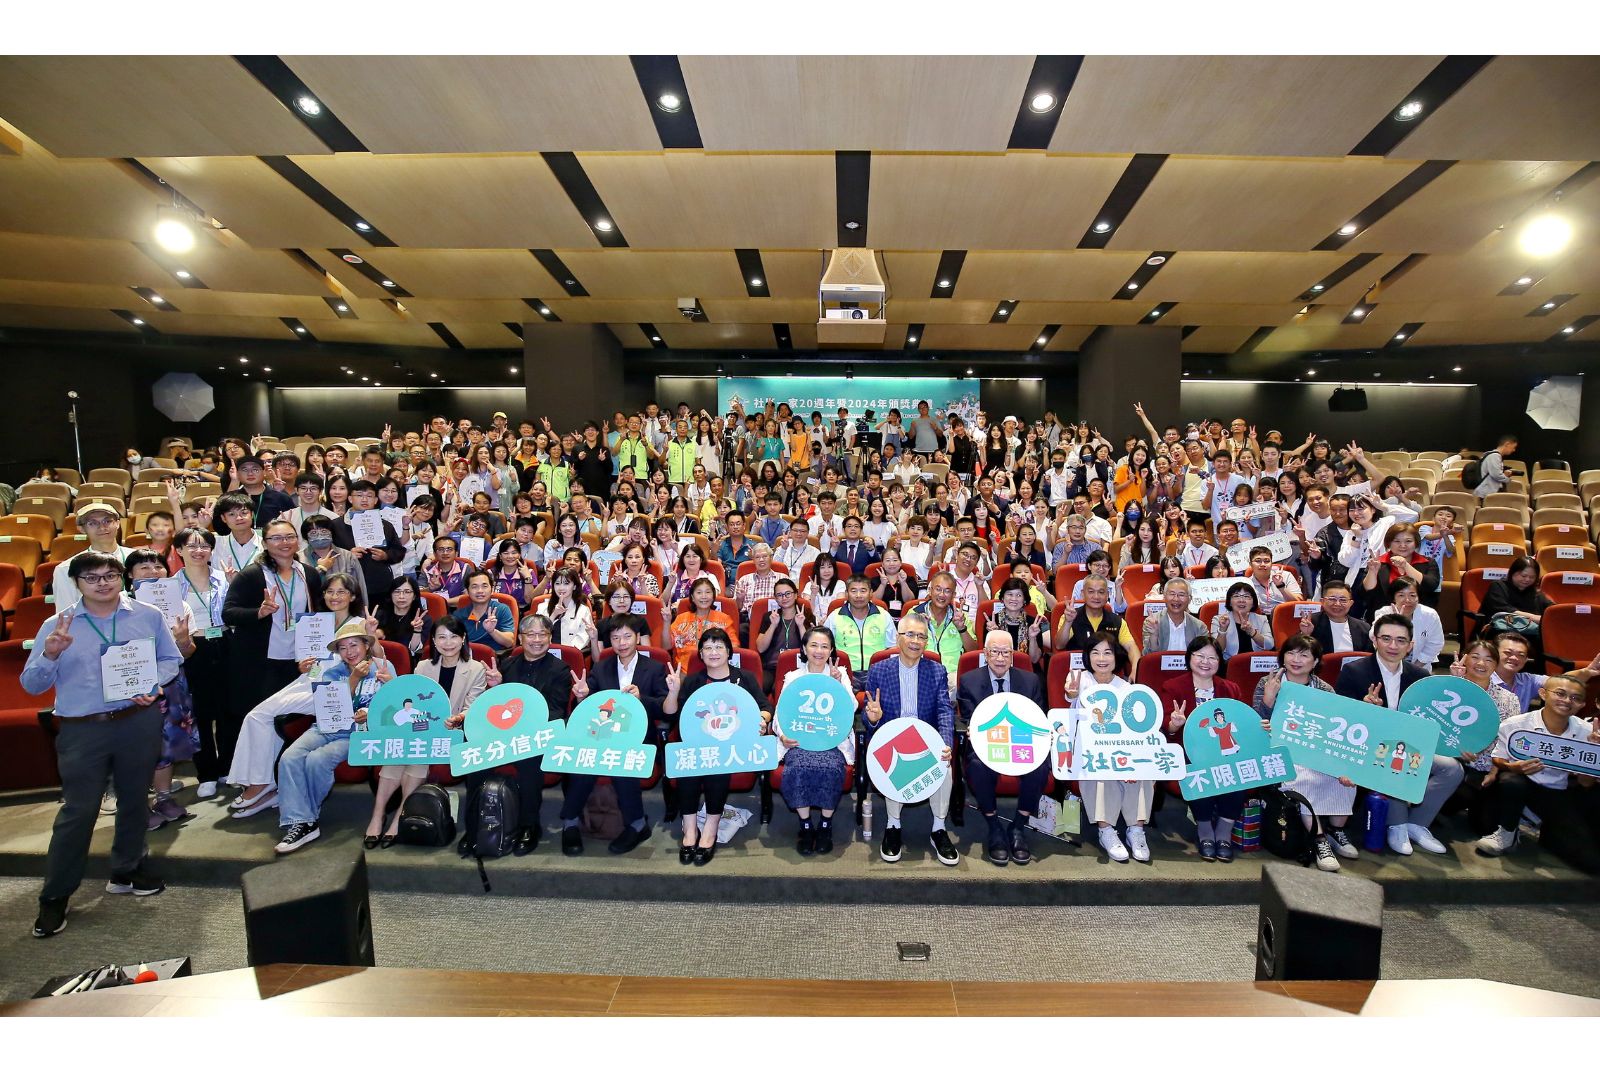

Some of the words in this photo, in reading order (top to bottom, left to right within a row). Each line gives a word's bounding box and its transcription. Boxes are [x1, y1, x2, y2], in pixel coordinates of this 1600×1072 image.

[754, 397, 933, 410] 社一家20週年暨2024年頒獎典
[798, 690, 834, 715] 20
[1086, 690, 1158, 735] 20
[1431, 689, 1478, 726] 20
[1146, 733, 1161, 746] th
[1326, 716, 1369, 746] 20
[361, 738, 452, 760] 不限主題
[460, 728, 556, 768] 充分信任
[551, 745, 647, 772] 不限年齡
[675, 743, 769, 770] 凝聚人心
[1323, 739, 1368, 756] ANNIVERSARY
[1359, 743, 1369, 751] th
[1539, 741, 1599, 765] 築夢個
[902, 767, 944, 801] 信義房屋
[1185, 753, 1287, 792] 不限國籍
